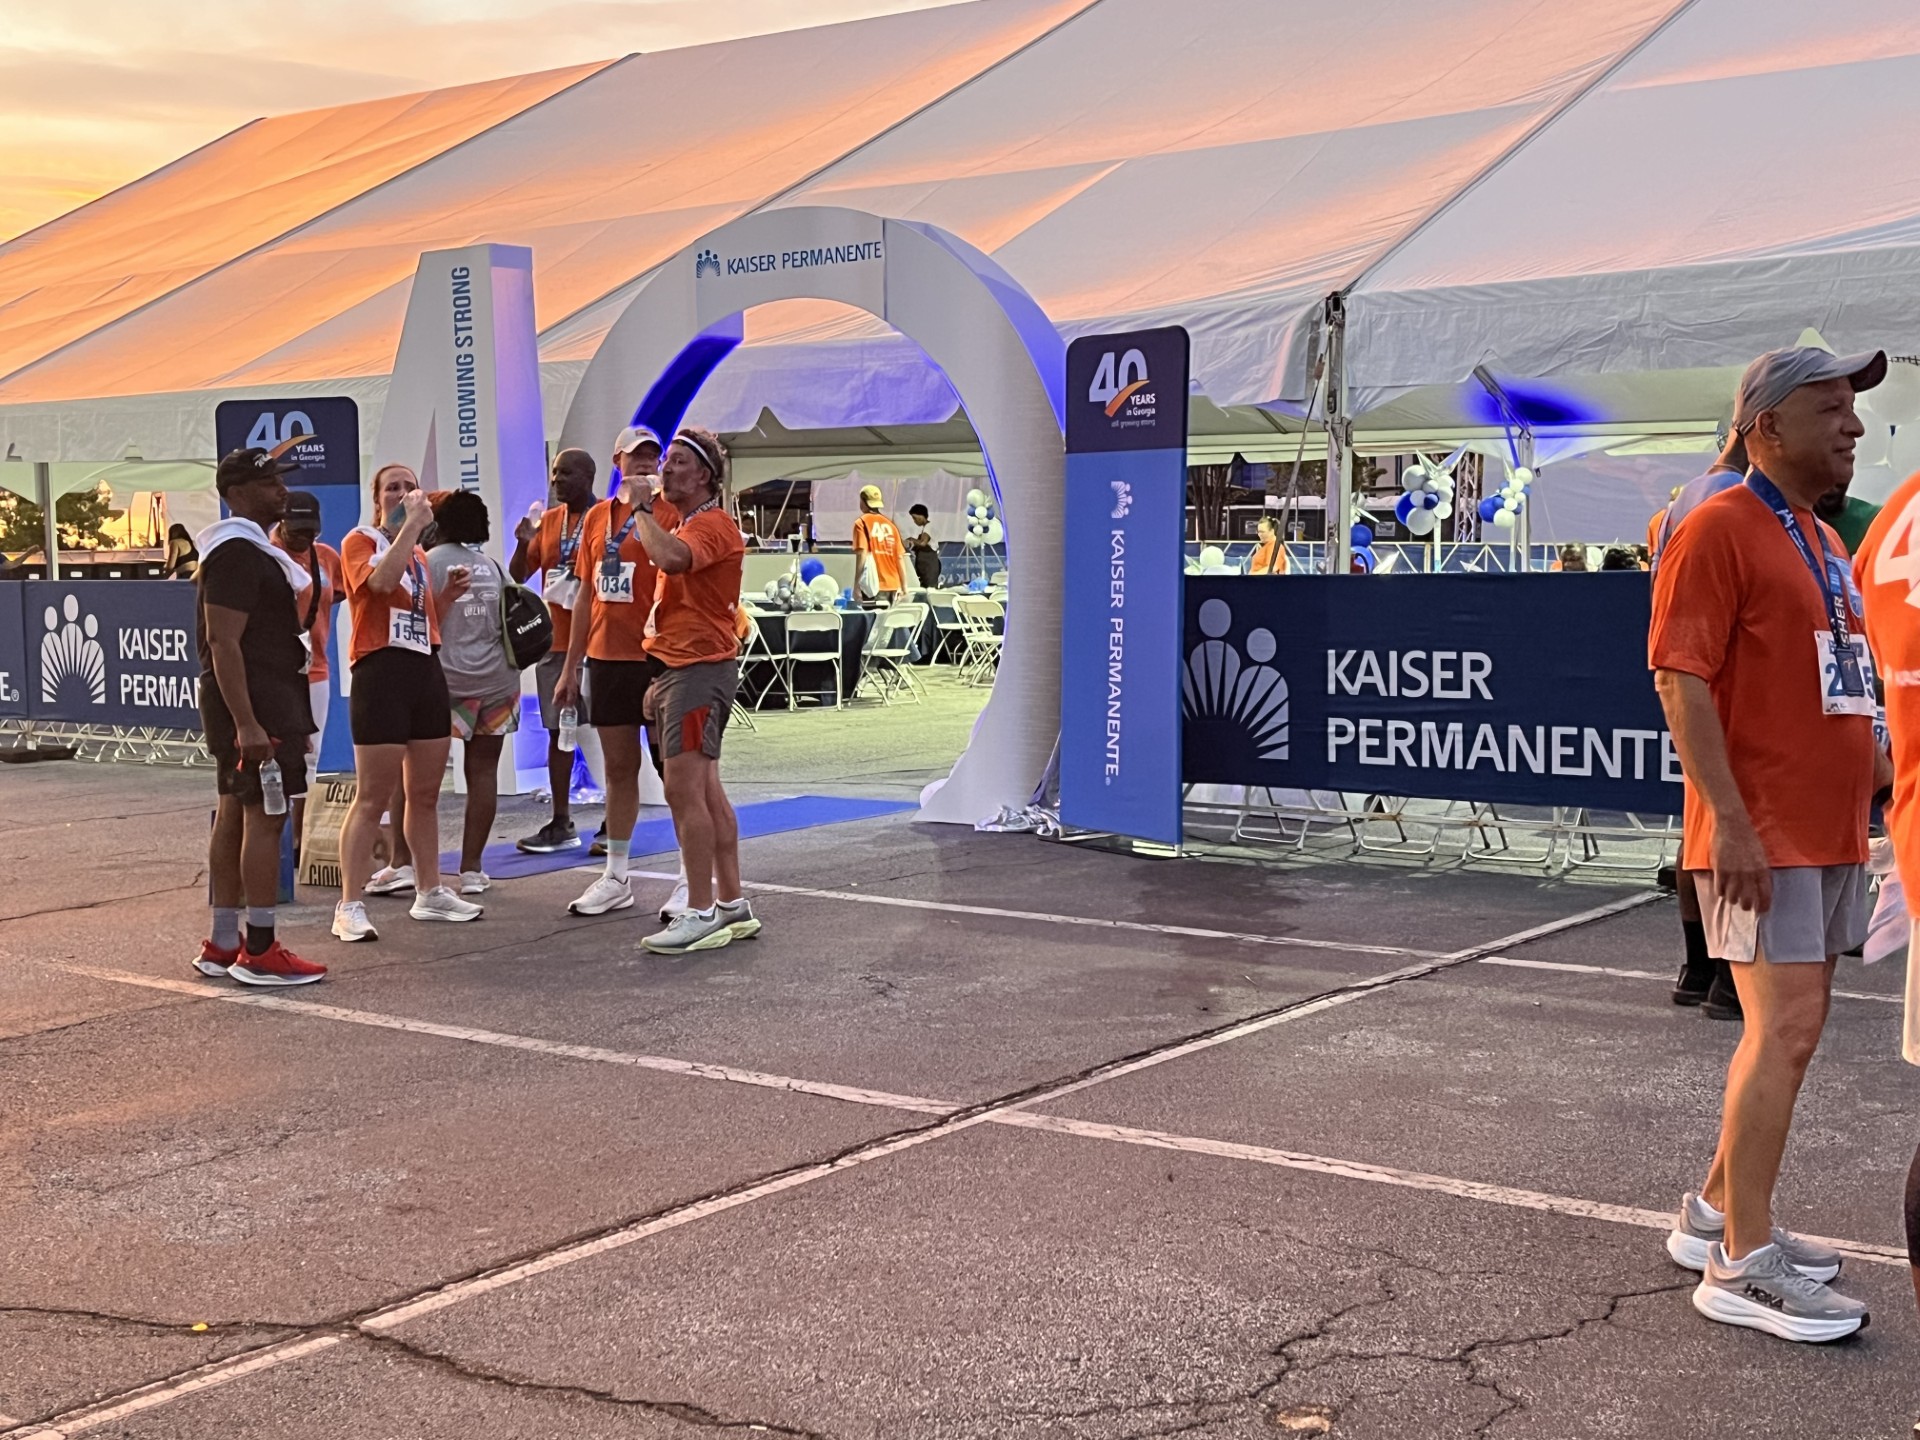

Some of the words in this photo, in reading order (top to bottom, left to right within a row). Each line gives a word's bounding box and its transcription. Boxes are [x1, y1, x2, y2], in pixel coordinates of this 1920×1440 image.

[727, 254, 776, 275] KAISER
[782, 241, 882, 270] PERMANENTE
[450, 265, 474, 348] STRONG
[1088, 348, 1148, 408] 40
[455, 352, 478, 449] GROWING
[1130, 393, 1156, 405] YEARS
[1132, 407, 1156, 417] Georgia
[246, 410, 314, 453] 40
[295, 443, 325, 453] YEARS
[299, 454, 325, 462] Georgia
[460, 452, 480, 494] TILL
[596, 577, 631, 594] 1034
[1110, 529, 1125, 609] KAISER
[118, 627, 189, 662] KAISER
[516, 616, 542, 635] thrive
[1327, 649, 1494, 701] KAISER
[1327, 717, 1685, 783] PERMANENTE
